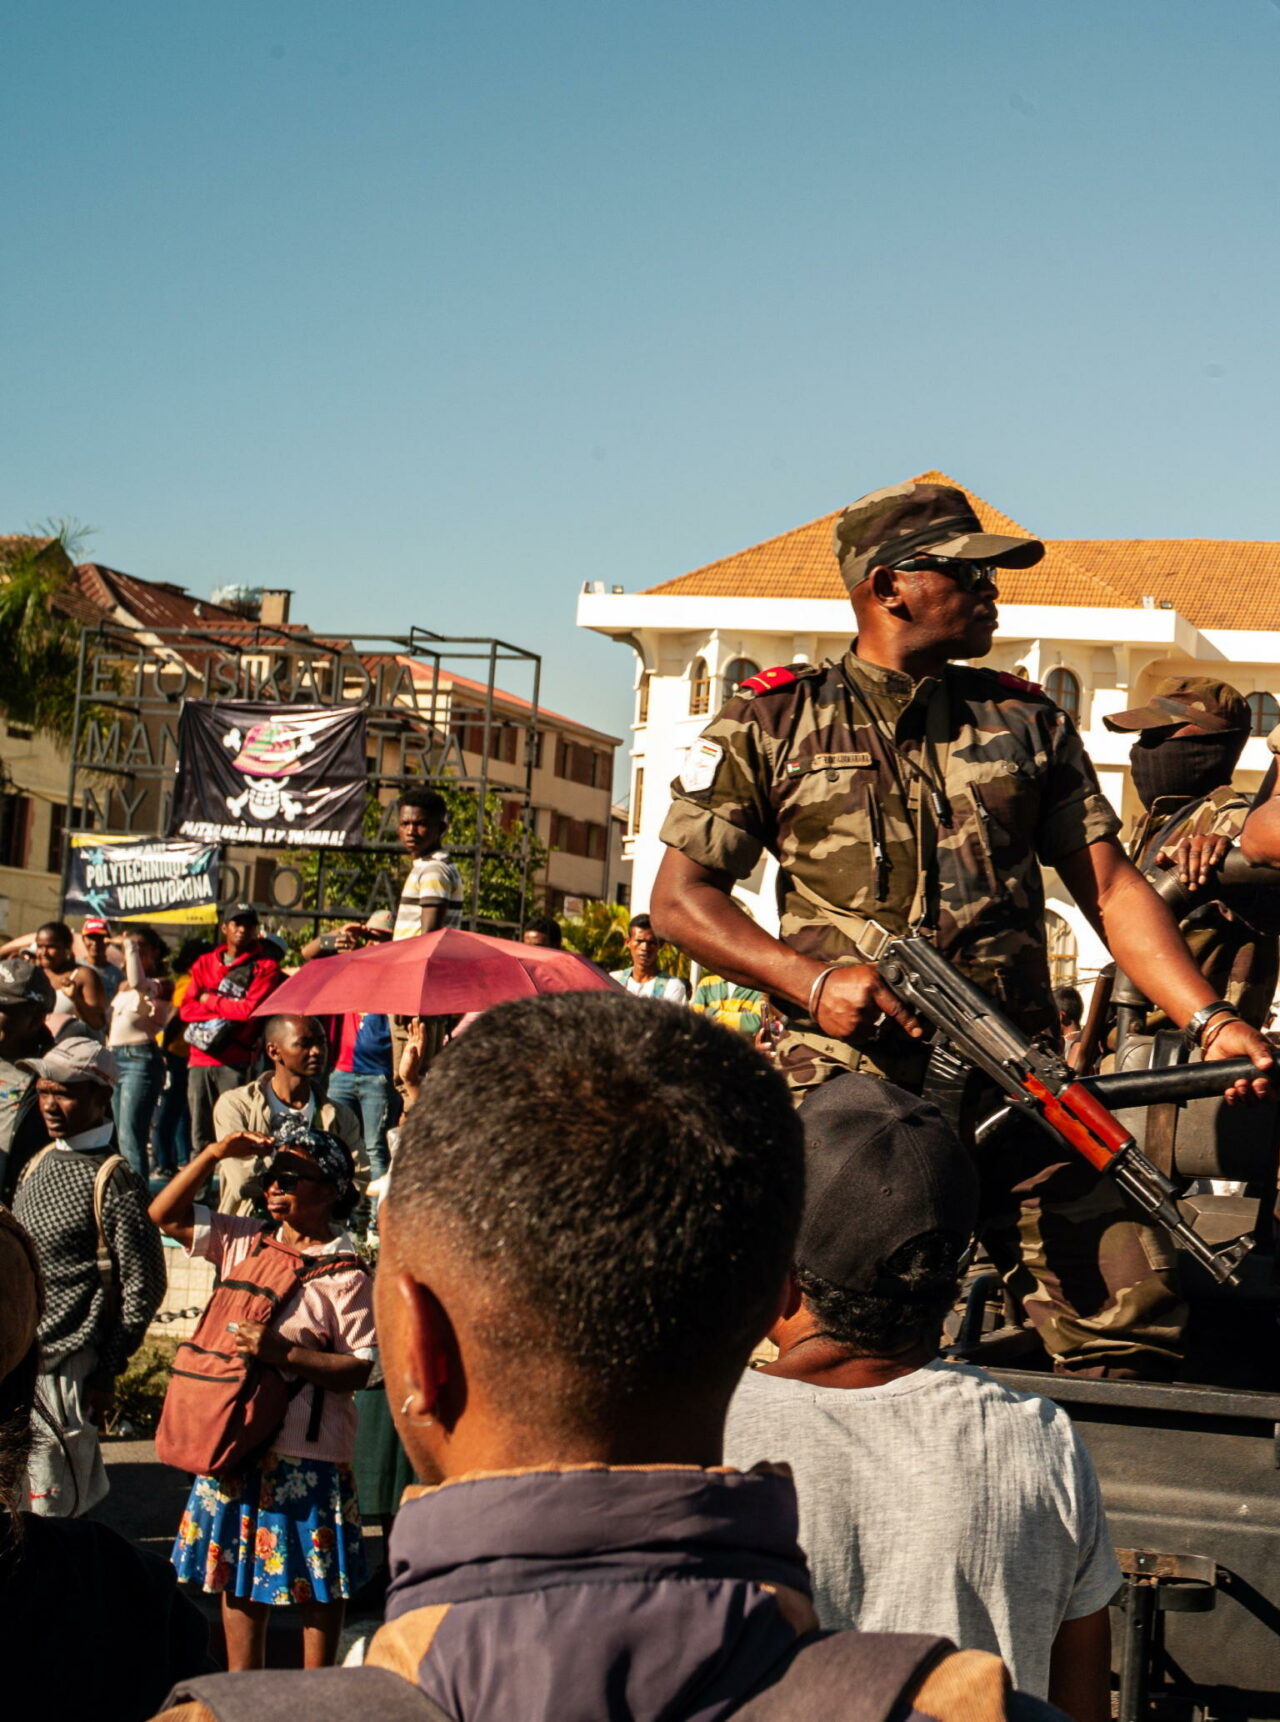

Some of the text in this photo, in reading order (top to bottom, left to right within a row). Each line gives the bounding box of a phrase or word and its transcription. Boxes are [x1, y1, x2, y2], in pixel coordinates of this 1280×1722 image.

[202, 656, 321, 705] ISIKA
[81, 787, 149, 832] NY
[86, 858, 189, 889] POLYTECHNIQUE
[117, 873, 213, 911] VONTOVORONA
